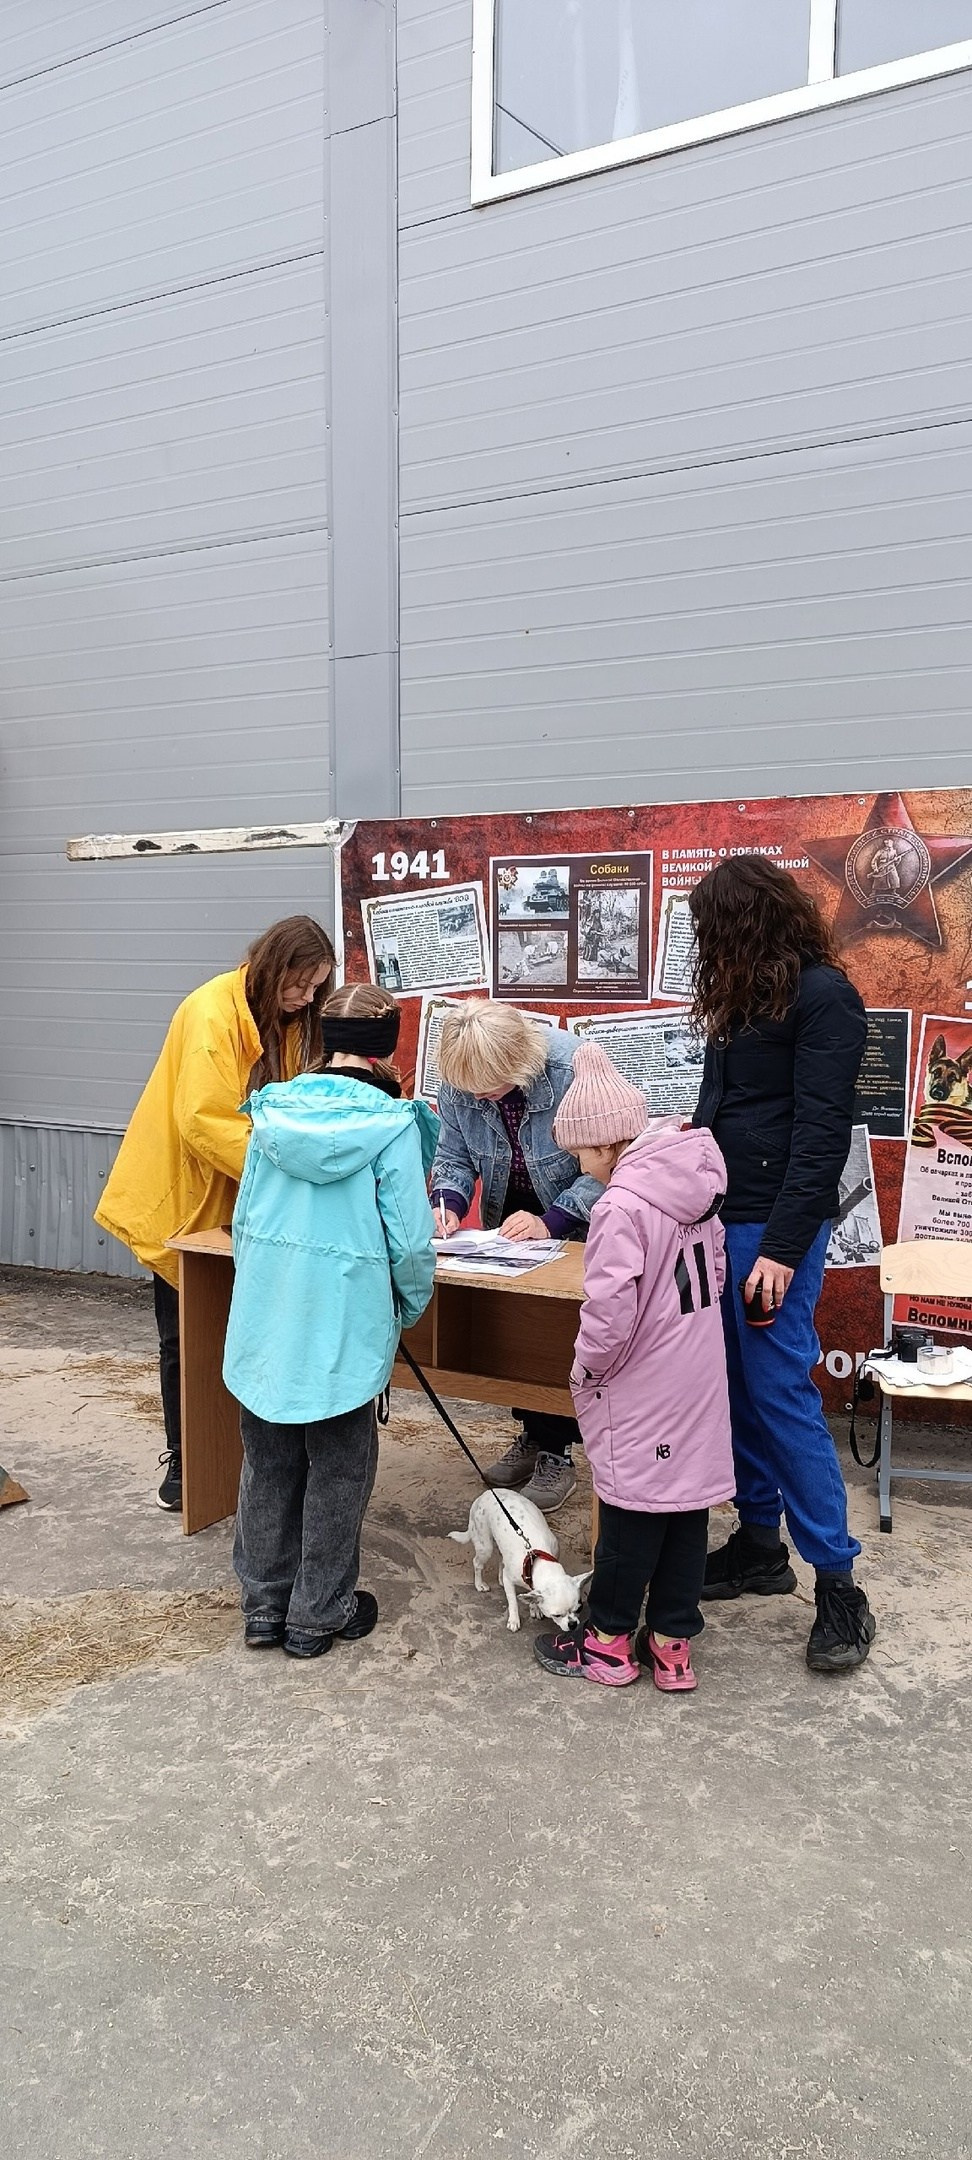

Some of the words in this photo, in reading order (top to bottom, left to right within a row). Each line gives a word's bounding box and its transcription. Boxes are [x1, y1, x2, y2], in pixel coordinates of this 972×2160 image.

[662, 850, 669, 860] В
[672, 848, 717, 860] ПАМЯТЬ
[718, 847, 727, 857] О
[729, 845, 783, 857] СОБАКАХ
[371, 849, 451, 881] 1941
[590, 863, 630, 875] Собаки
[662, 860, 713, 873] ВЕЛИКОЙ
[920, 1166, 929, 1174] Об
[932, 1194, 960, 1204] Великой
[939, 1209, 951, 1217] Мы
[932, 1217, 955, 1226] более
[957, 1220, 970, 1228] 700
[914, 1224, 958, 1235] уничтожили
[920, 1297, 935, 1305] НАМ
